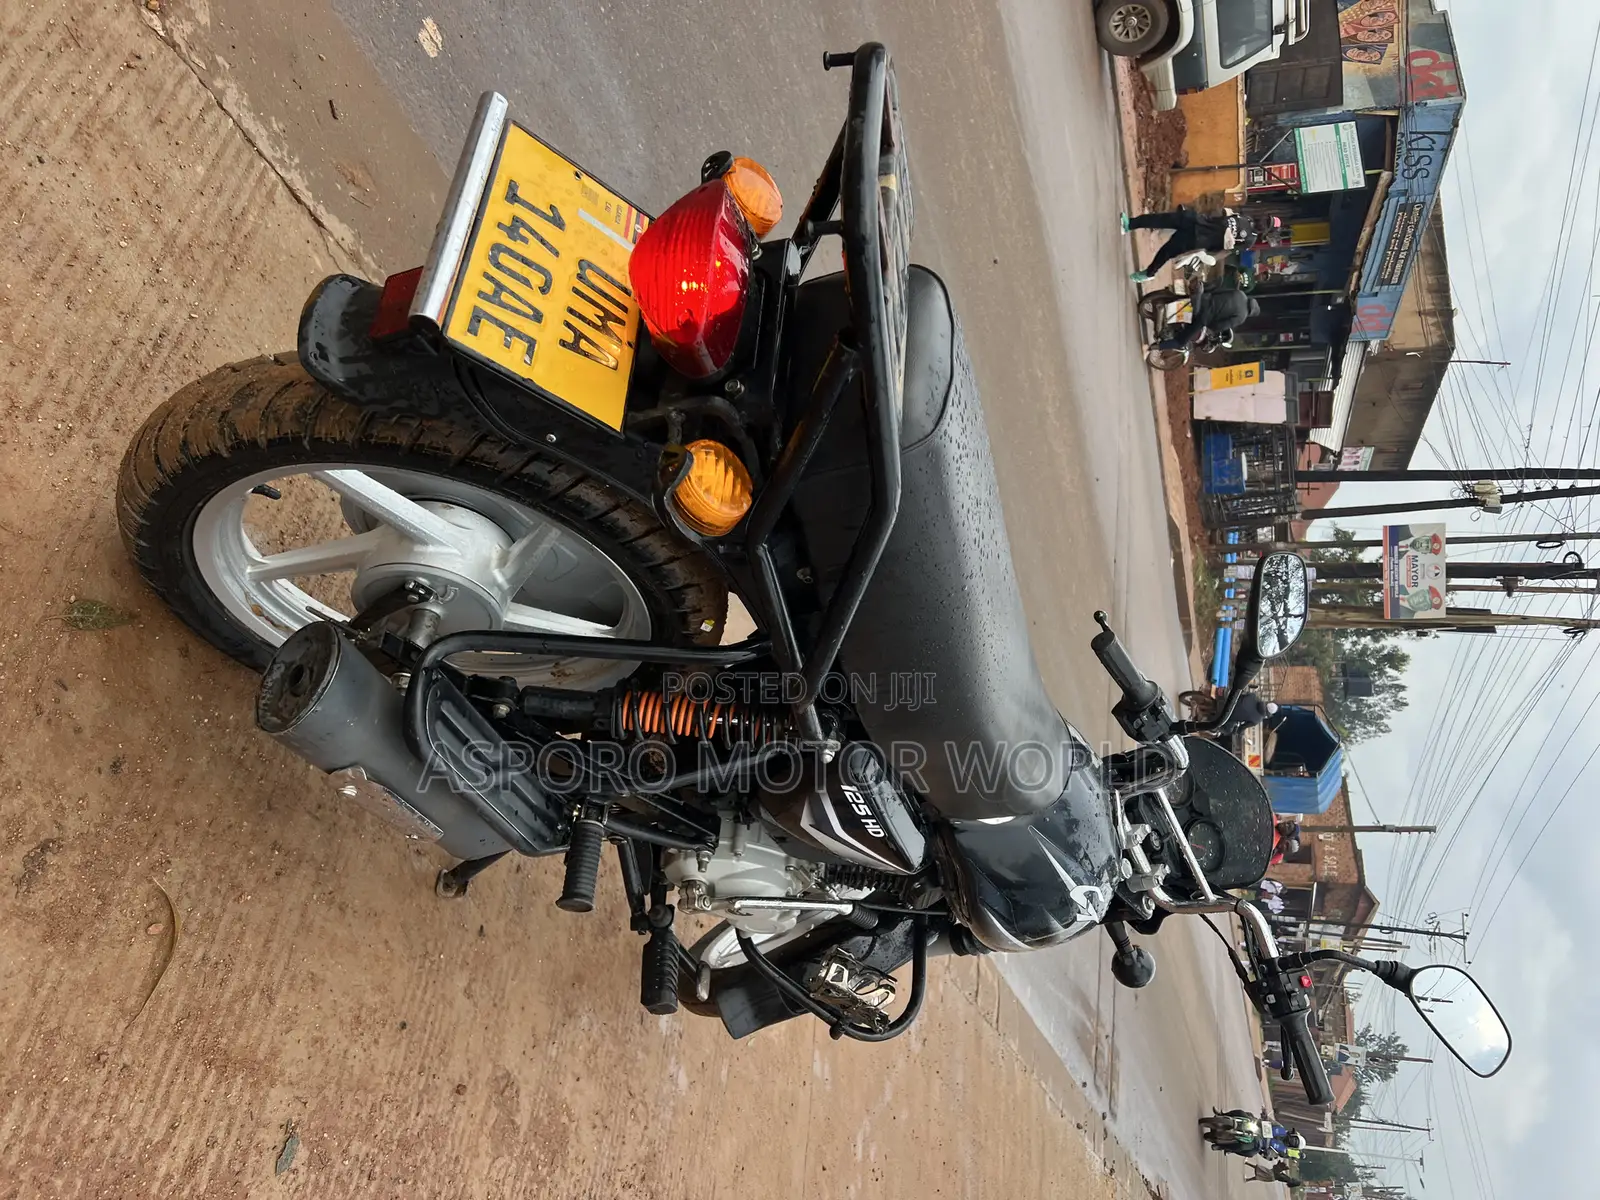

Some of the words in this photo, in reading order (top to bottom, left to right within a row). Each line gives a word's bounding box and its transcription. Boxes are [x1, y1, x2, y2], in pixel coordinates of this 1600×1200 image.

[1400, 225, 1415, 250] condoms
[467, 179, 566, 366] 140AE
[1390, 259, 1404, 284] maximum
[558, 259, 632, 370] UMA
[841, 784, 872, 816] 125
[860, 818, 885, 838] HD
[1323, 855, 1337, 876] SALE
